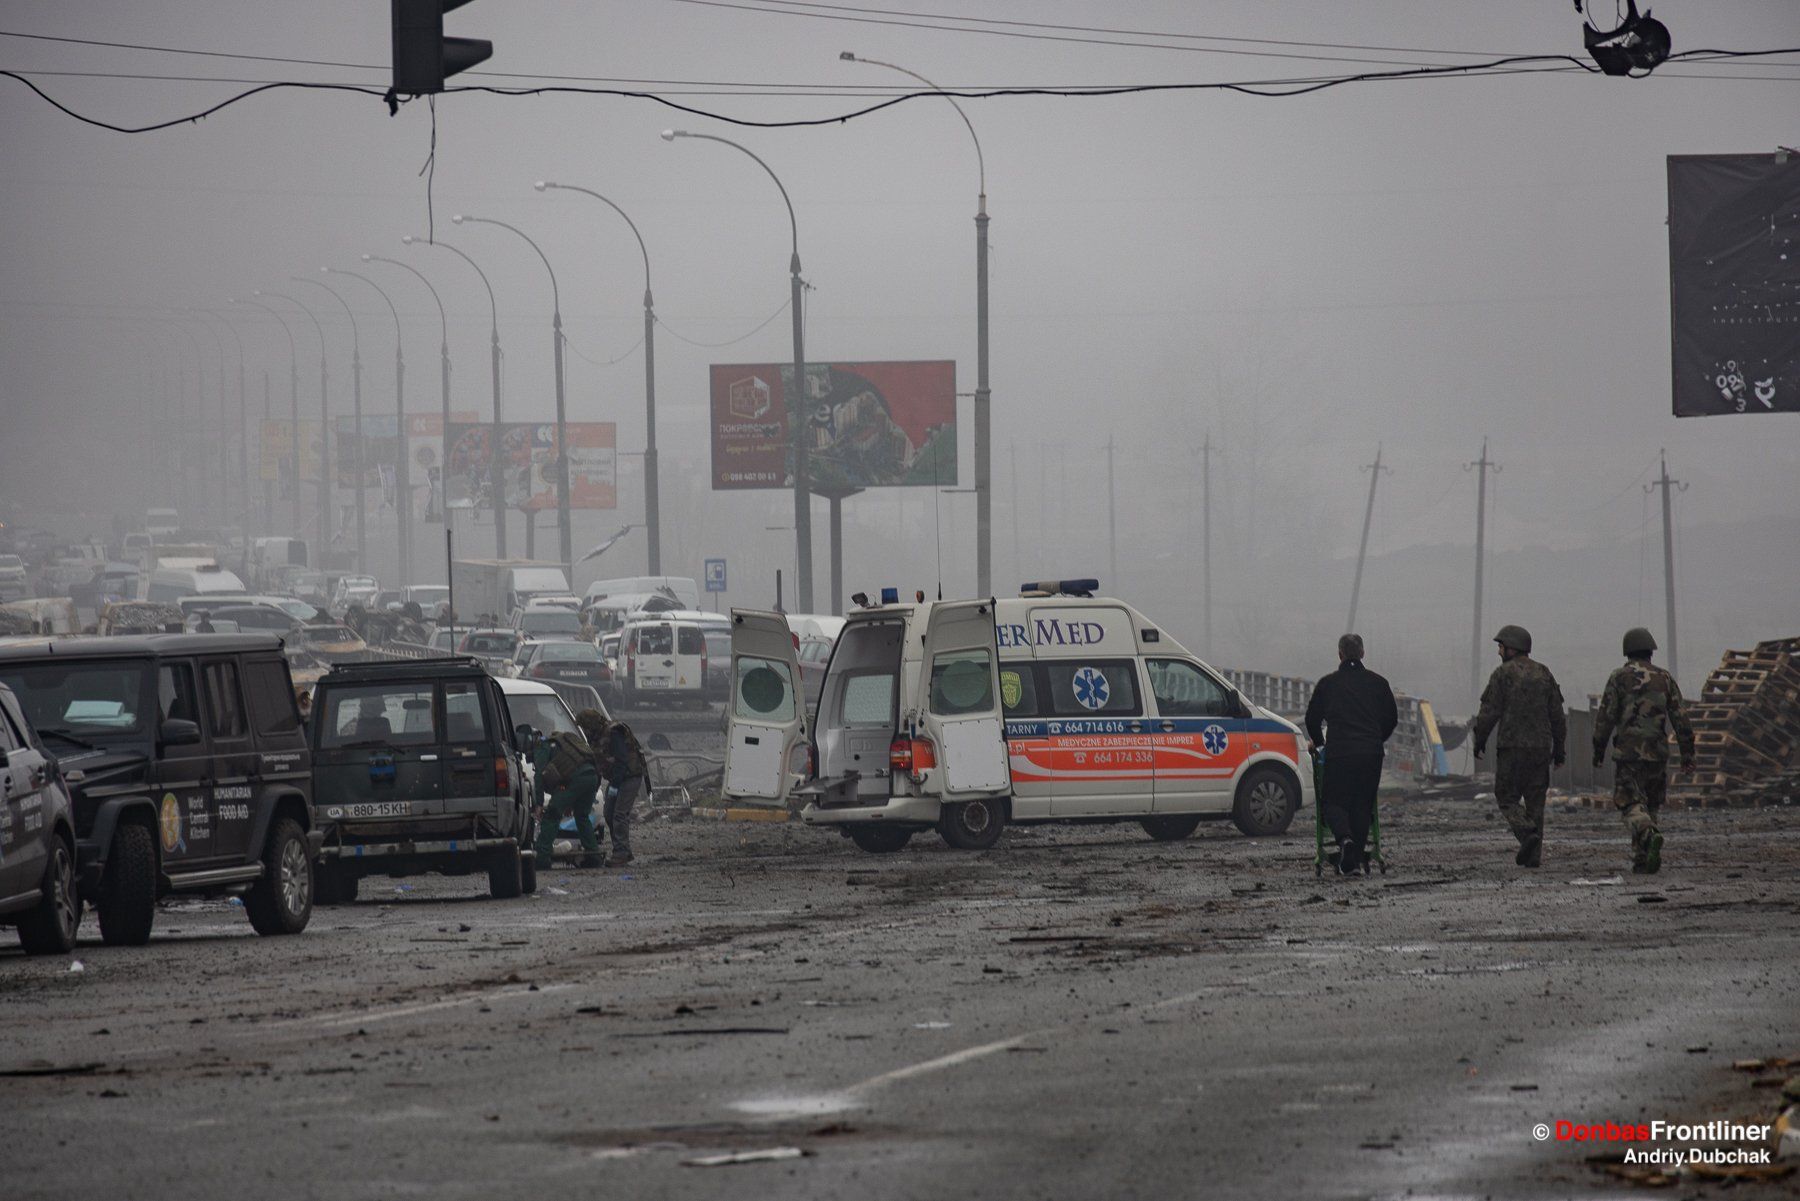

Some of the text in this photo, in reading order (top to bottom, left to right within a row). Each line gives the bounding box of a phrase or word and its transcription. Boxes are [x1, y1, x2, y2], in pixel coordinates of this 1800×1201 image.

[1065, 722, 1083, 733] 664
[1085, 722, 1102, 733] 714
[1106, 722, 1124, 733] 616
[1057, 736, 1194, 748] MEDYCZNE ZABEZPIECZENIE IMPREZ
[1094, 752, 1153, 763] 664 174 336
